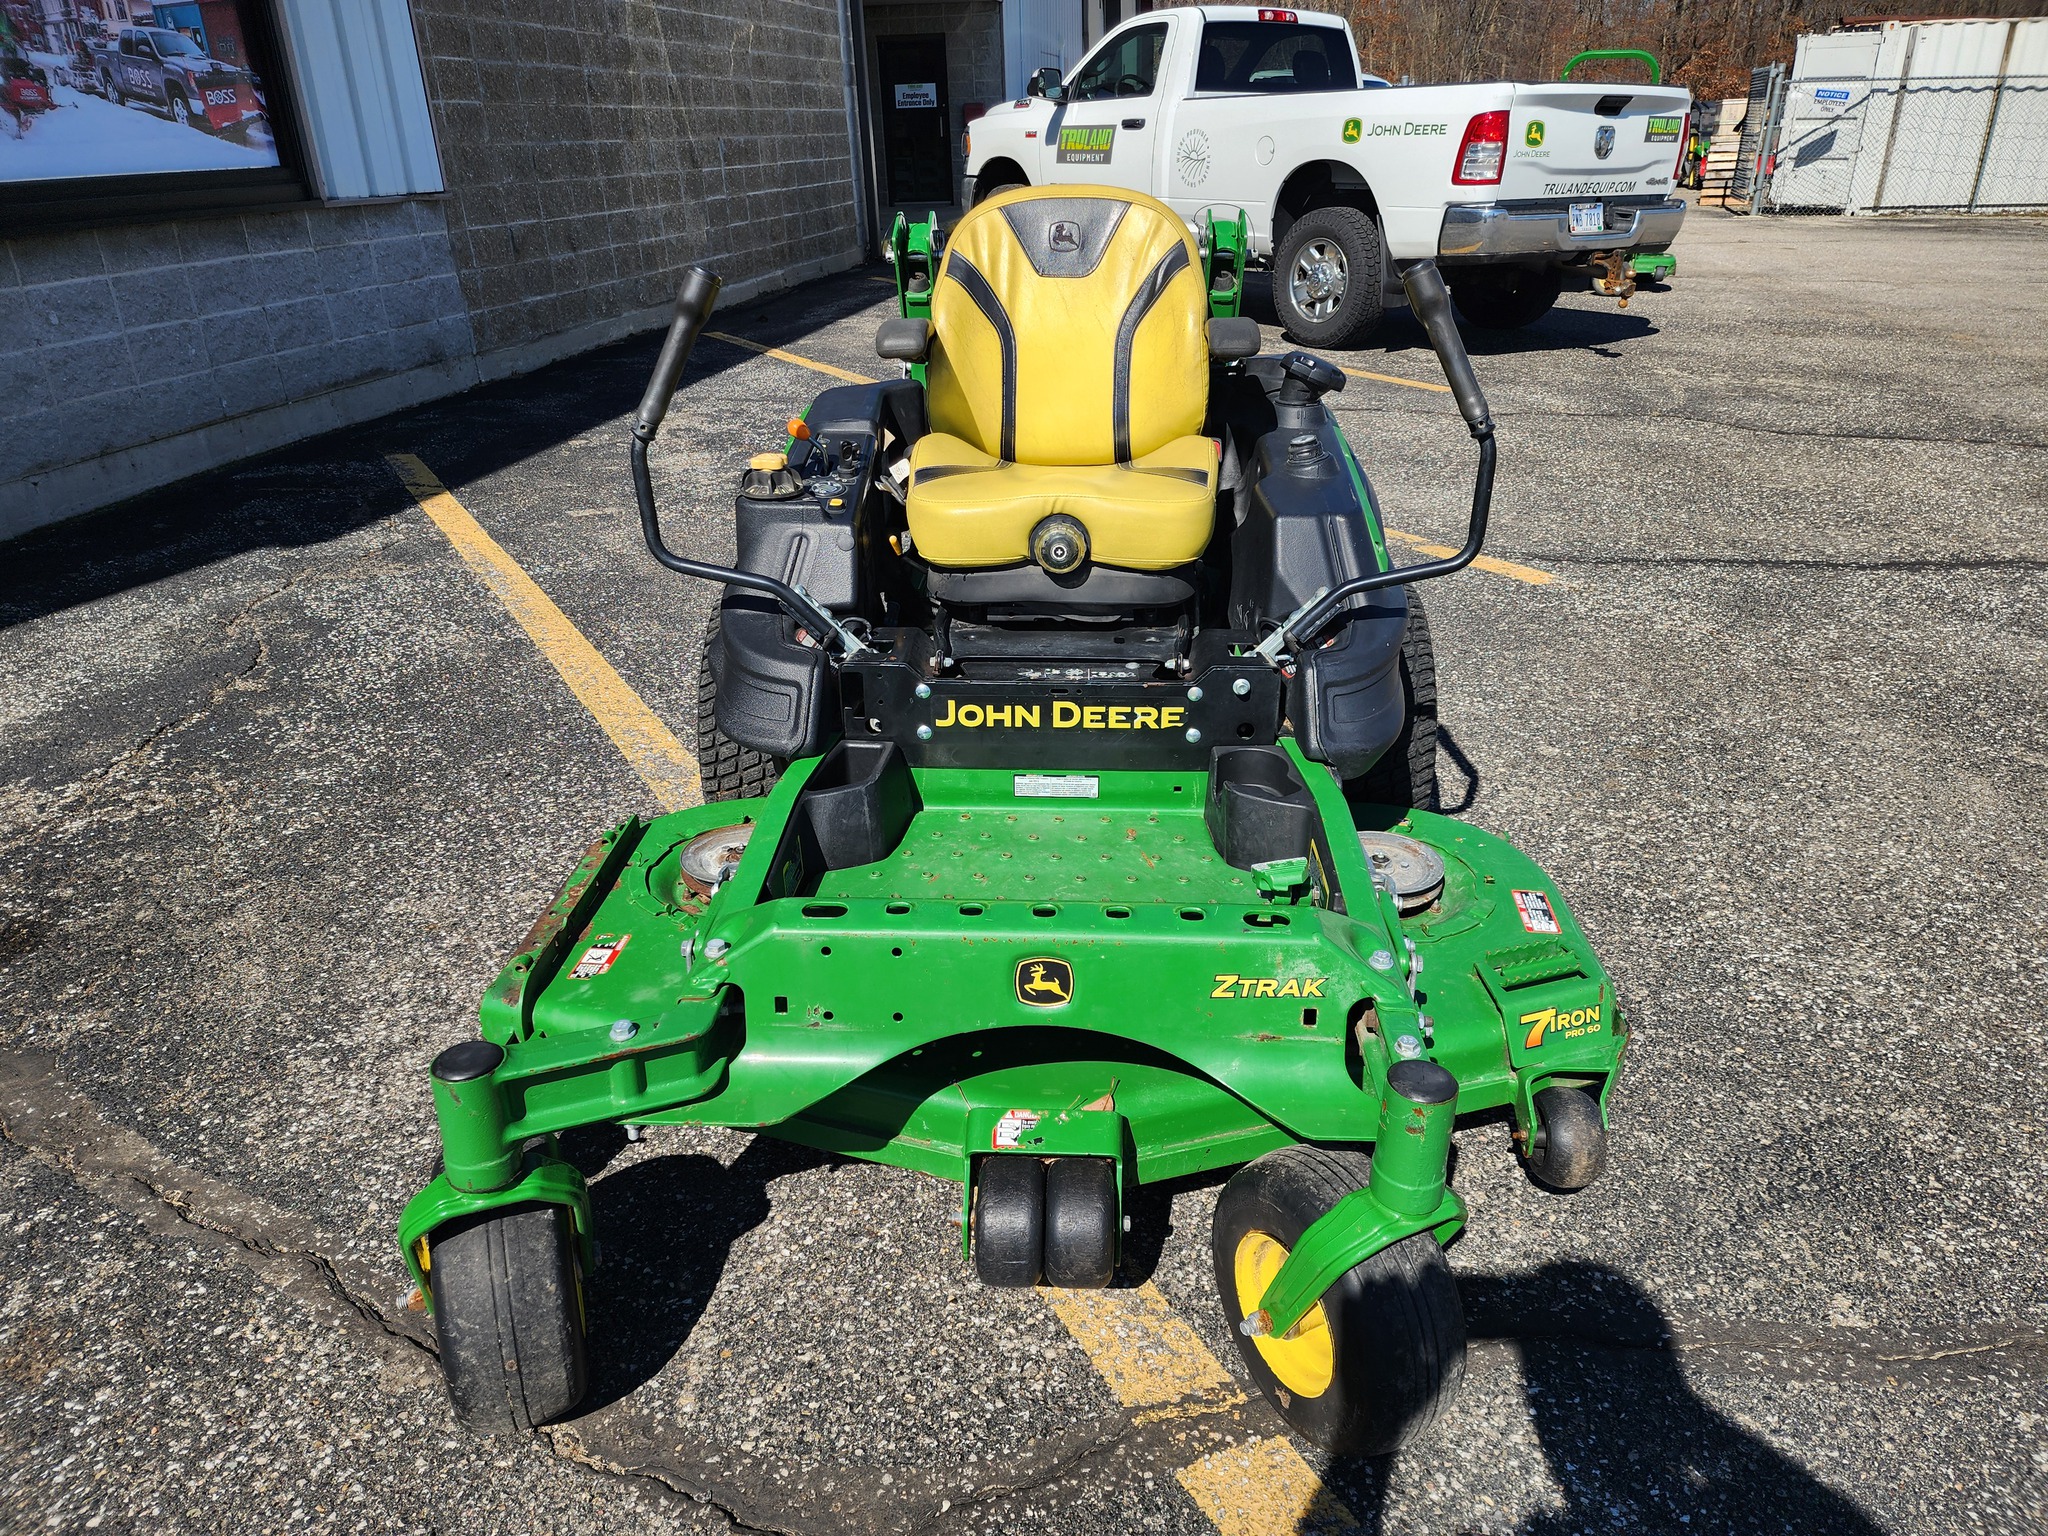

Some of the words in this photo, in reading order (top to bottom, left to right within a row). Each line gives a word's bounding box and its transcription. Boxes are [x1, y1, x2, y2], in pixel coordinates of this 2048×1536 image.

[127, 67, 153, 89] BOSS
[20, 88, 38, 96] BOSS
[205, 88, 237, 106] BOSS
[902, 92, 929, 100] Employee
[1817, 90, 1848, 99] NOTICE
[897, 99, 922, 107] Entrance
[922, 98, 935, 107] Only
[1813, 99, 1846, 107] EMPLOYEES
[1367, 123, 1401, 137] JOHN
[1403, 122, 1448, 136] DEERE
[1648, 118, 1681, 134] TRULAND
[1060, 128, 1114, 150] TRULAND
[1066, 153, 1105, 163] EQUIPMENT
[1513, 150, 1530, 158] JOHN
[1530, 149, 1551, 158] DEERE
[1542, 181, 1637, 196] TRULANDEQUIP.COM
[1585, 212, 1601, 227] 7818
[935, 700, 1040, 728] JOHN
[1052, 700, 1186, 729] DEERE
[1210, 974, 1329, 999] ZTRAK
[1565, 1028, 1586, 1041] PRO
[1587, 1023, 1601, 1034] 60
